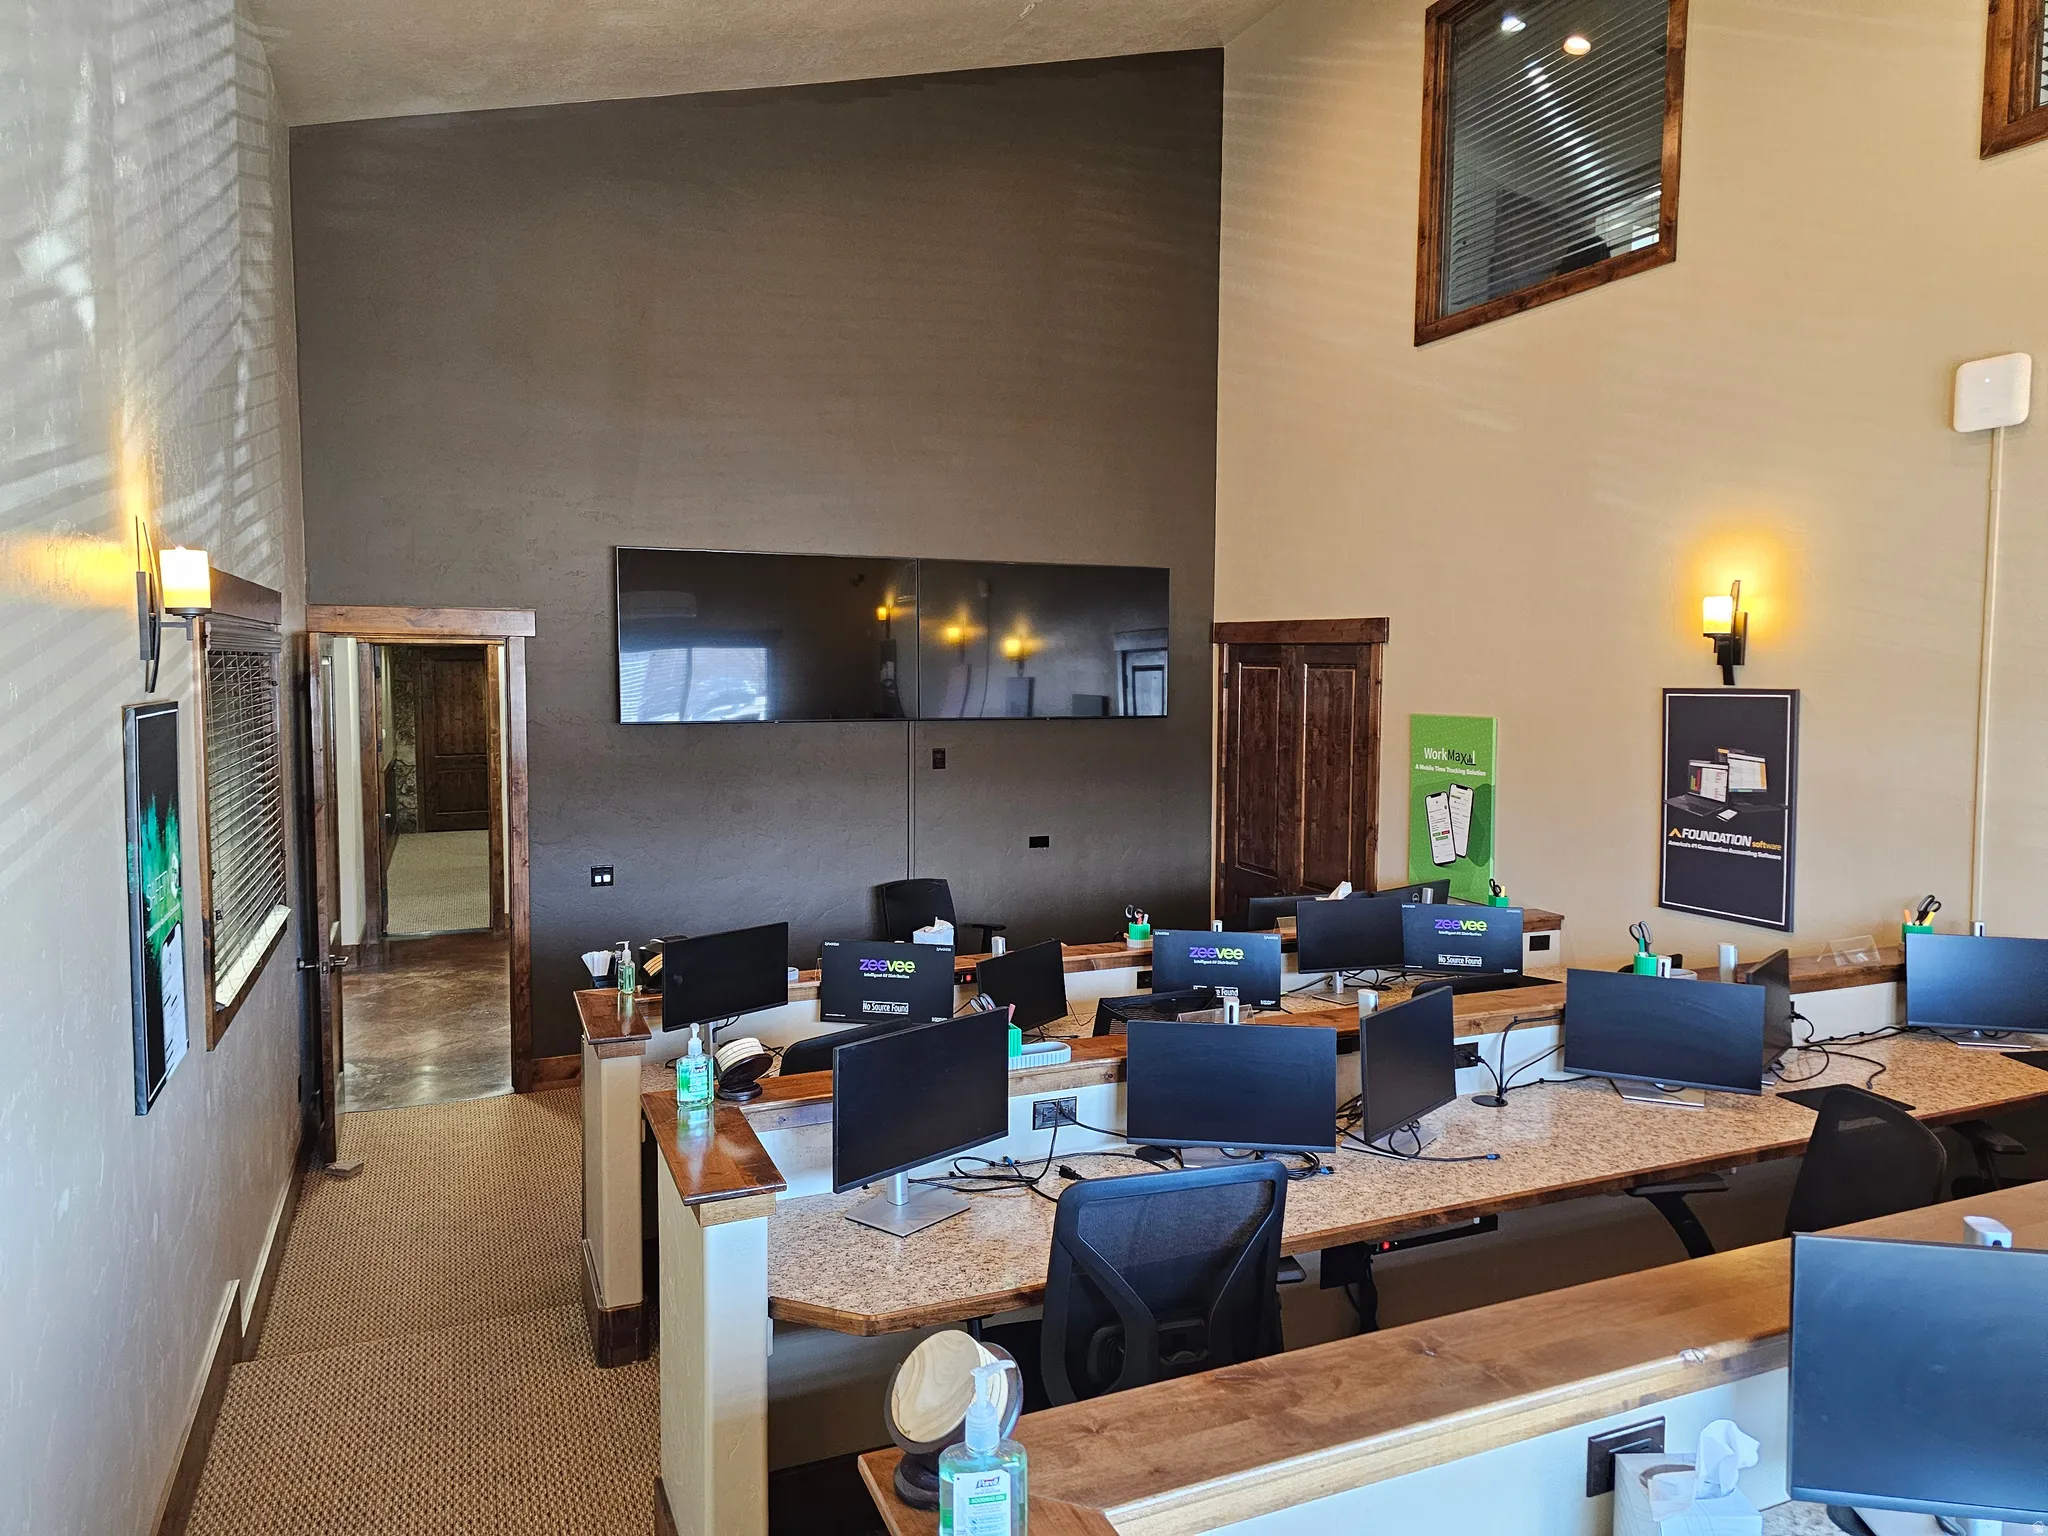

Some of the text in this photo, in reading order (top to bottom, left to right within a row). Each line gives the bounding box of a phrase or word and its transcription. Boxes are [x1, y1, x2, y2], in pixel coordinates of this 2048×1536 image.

[1424, 747, 1471, 765] WorkMax
[1446, 767, 1466, 775] Tracking
[1682, 828, 1782, 851] FOUNDATION software
[1757, 852, 1782, 860] Software
[1434, 919, 1487, 931] zeevee
[1189, 946, 1244, 960] zeevee
[860, 958, 916, 973] zeevee
[1438, 955, 1483, 966] No Source Found
[1221, 988, 1239, 997] Found
[863, 1001, 908, 1012] No Source Found
